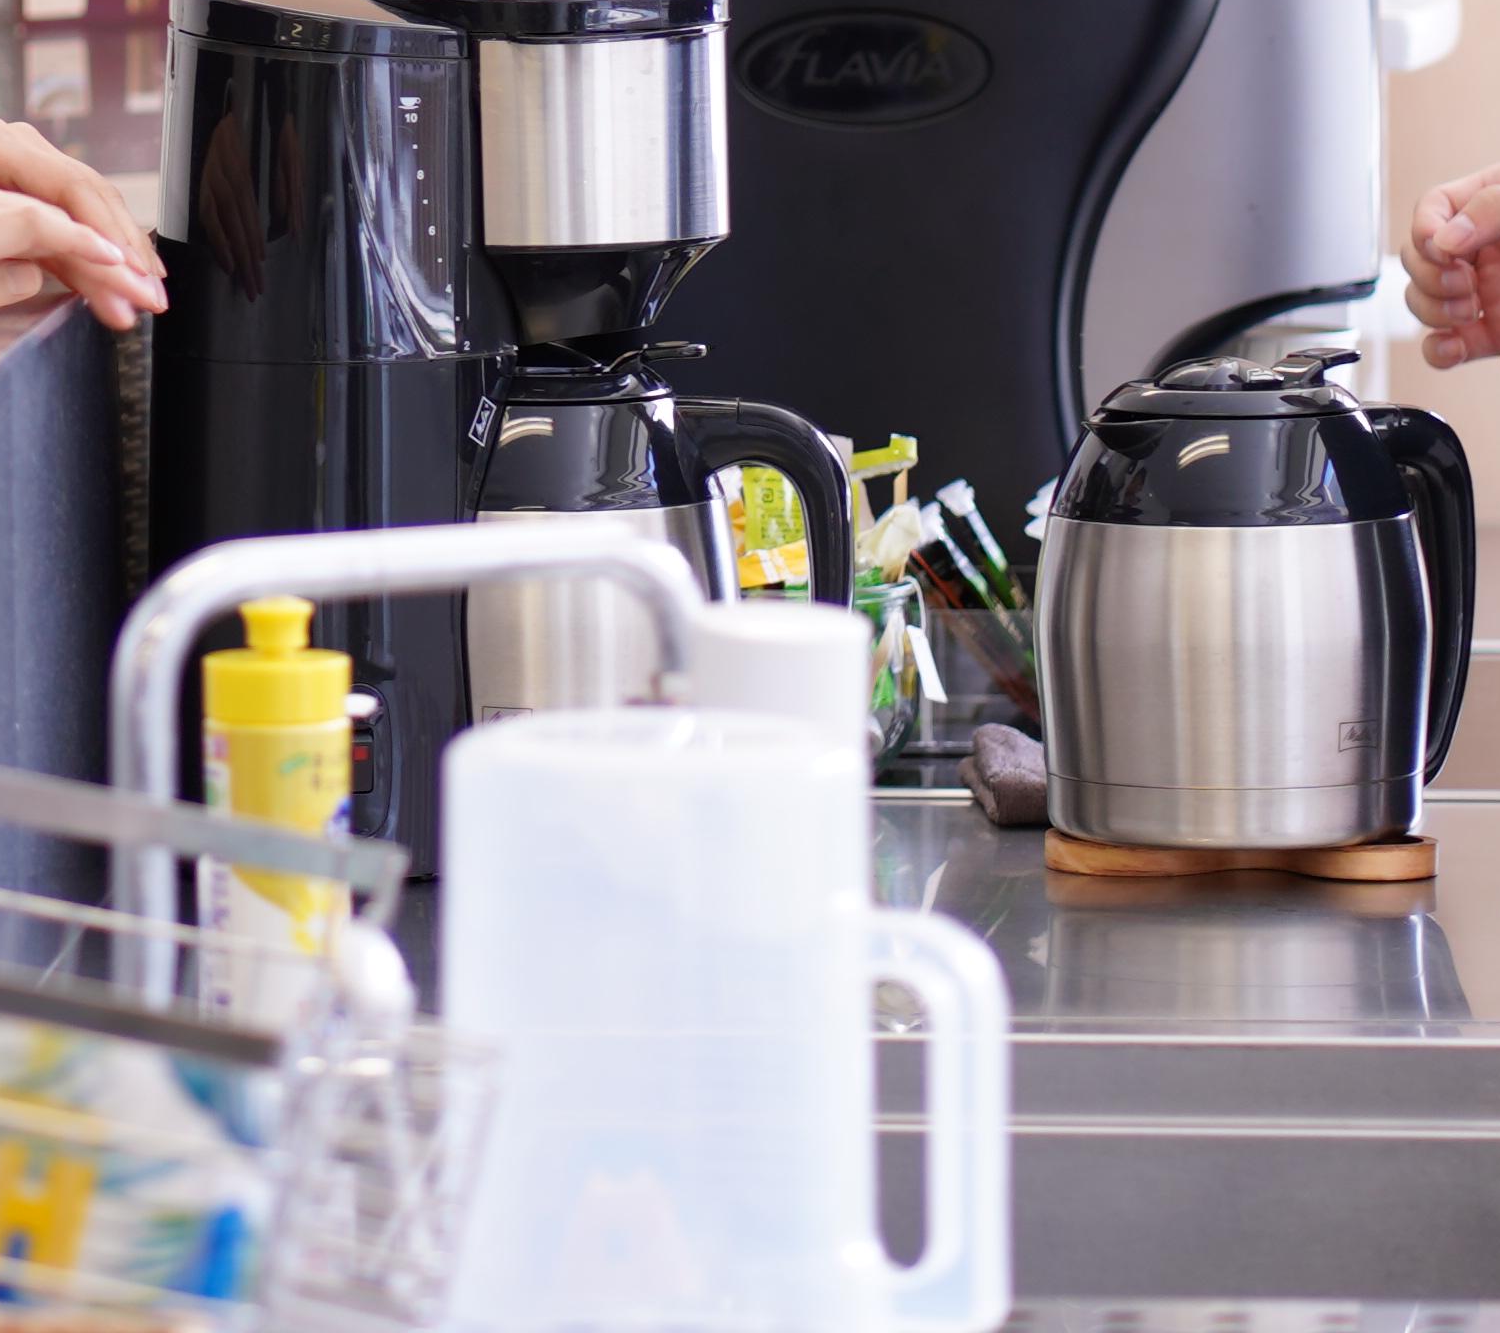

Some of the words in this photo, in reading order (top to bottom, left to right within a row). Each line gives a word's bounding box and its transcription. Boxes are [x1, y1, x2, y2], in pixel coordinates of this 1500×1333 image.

[404, 113, 418, 123] 10
[416, 169, 425, 180] 8
[428, 225, 436, 236] 6
[463, 340, 470, 351] 2
